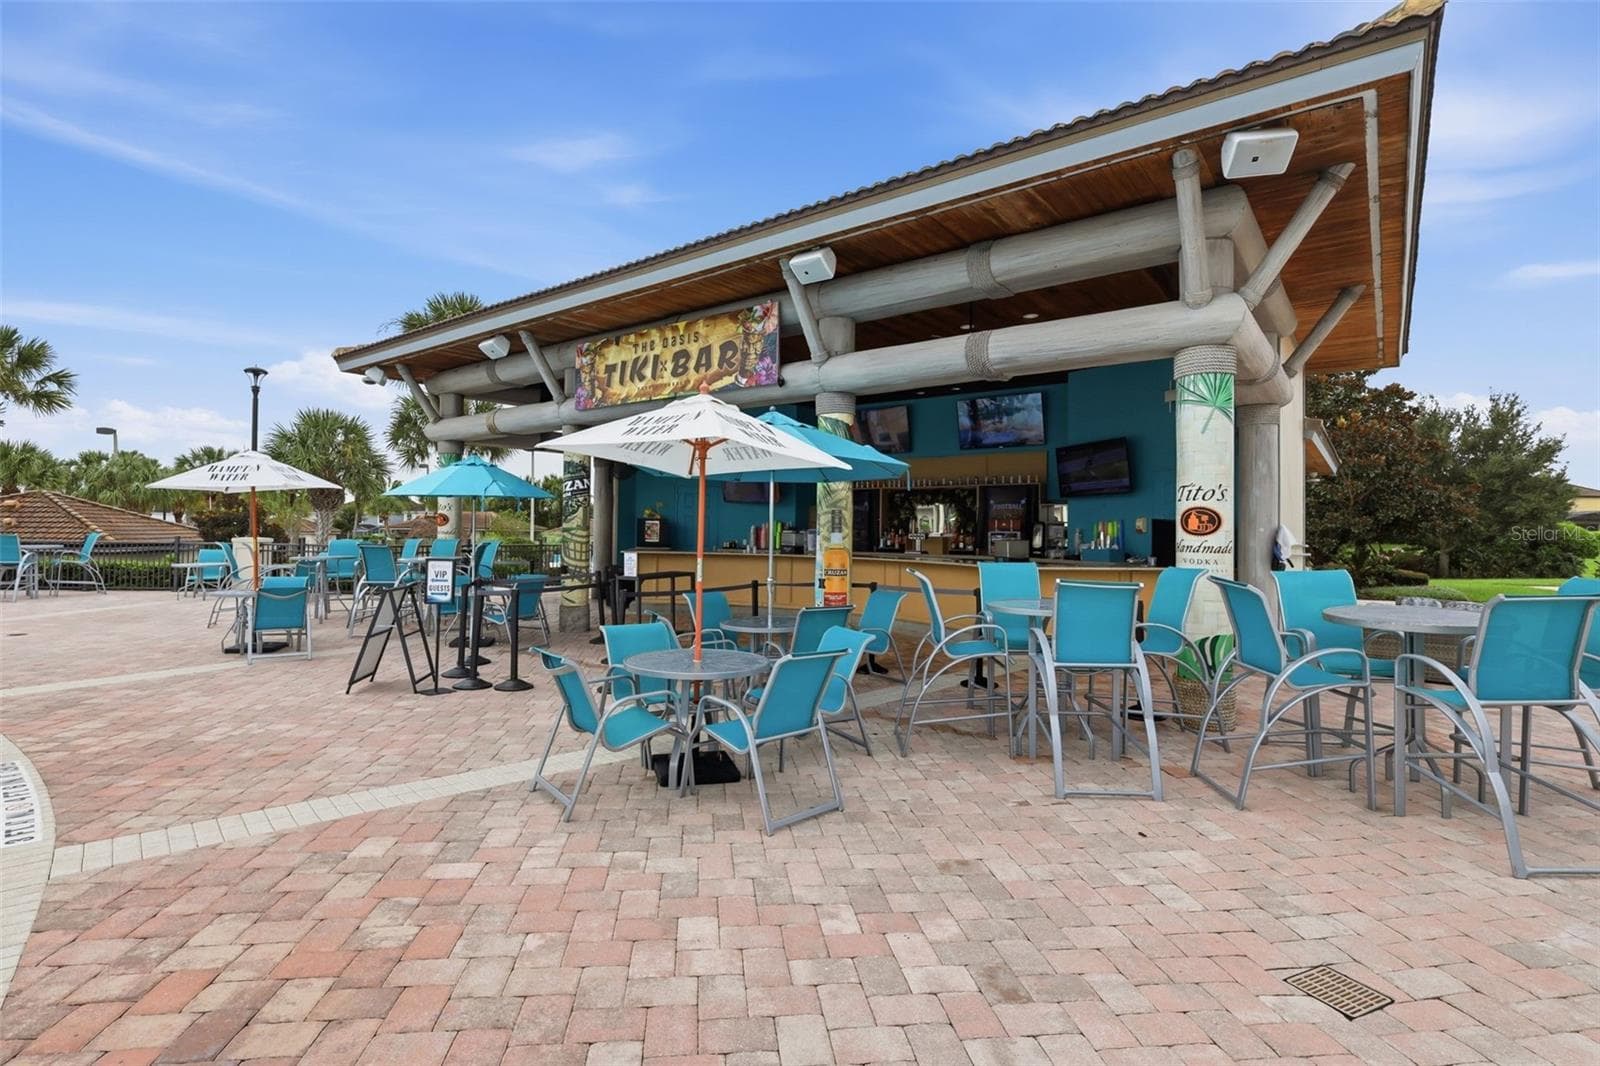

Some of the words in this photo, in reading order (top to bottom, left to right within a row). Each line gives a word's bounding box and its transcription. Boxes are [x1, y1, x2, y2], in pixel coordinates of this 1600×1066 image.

[604, 354, 660, 388] TIKI
[670, 340, 739, 379] BAR
[207, 464, 261, 472] HAMPTN
[209, 473, 249, 481] WATER
[1177, 482, 1228, 502] Tito's
[433, 570, 448, 578] VIP
